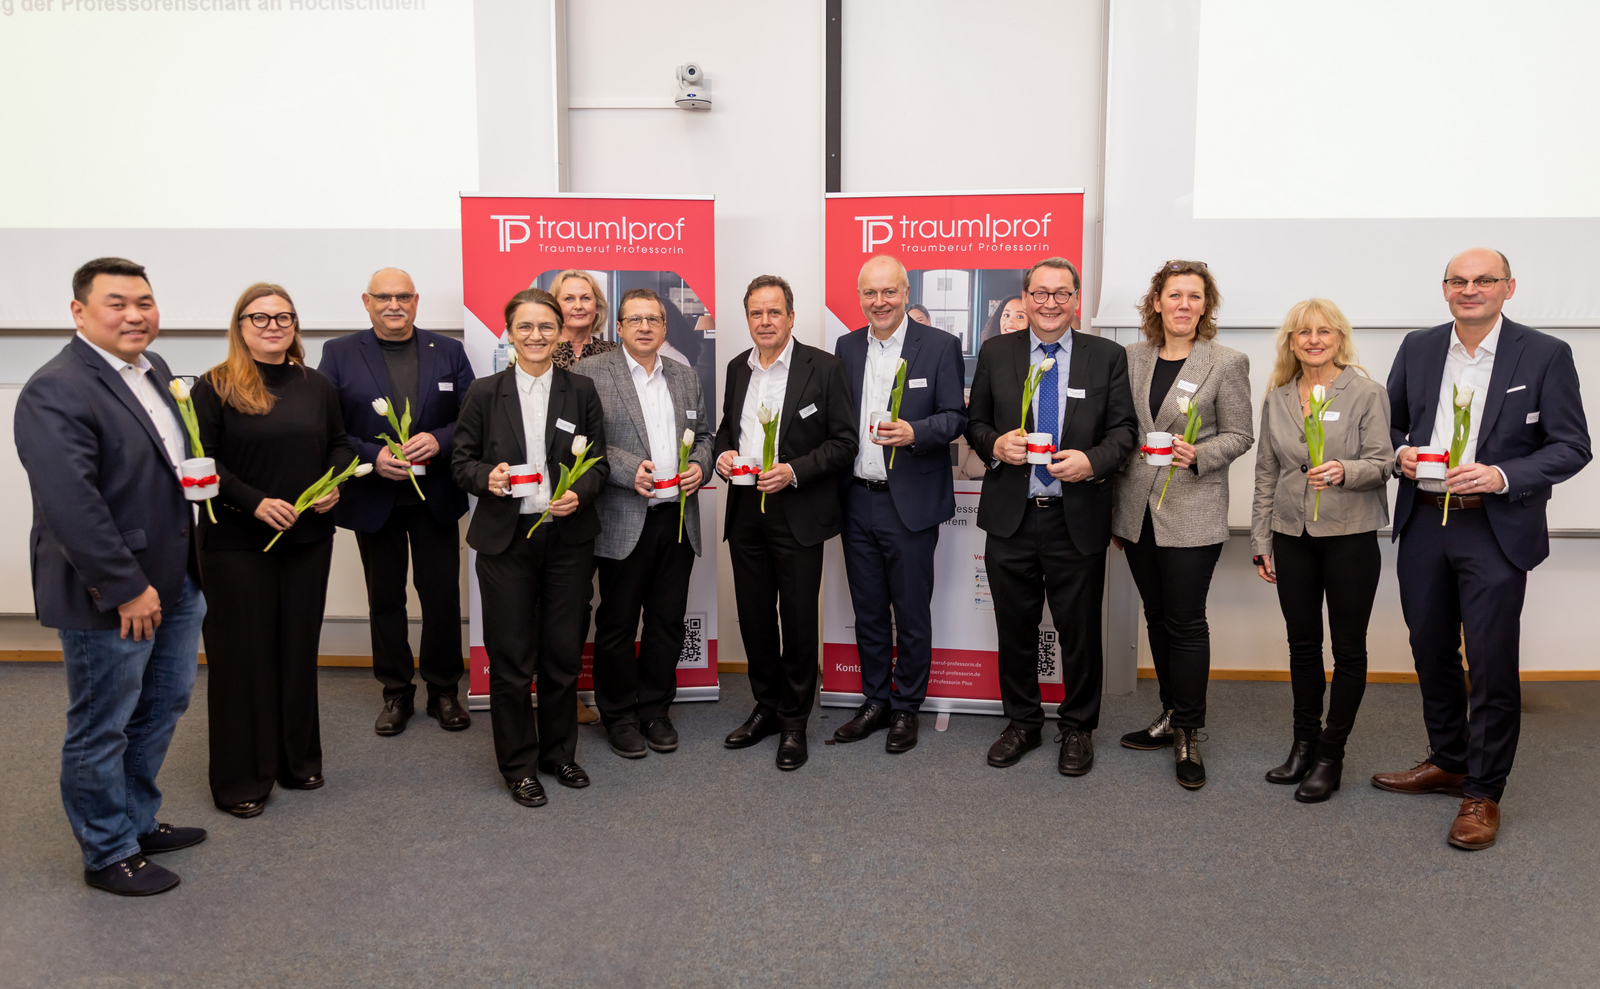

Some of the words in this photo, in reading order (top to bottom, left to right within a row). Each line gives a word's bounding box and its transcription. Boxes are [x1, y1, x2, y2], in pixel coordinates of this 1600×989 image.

[21, 0, 52, 11] der
[61, 0, 251, 11] Professorenschaft
[257, 0, 282, 11] an
[290, 0, 426, 11] Hochschulen
[539, 243, 610, 253] Traumberuf
[615, 244, 684, 254] Professorin
[901, 243, 973, 253] Traumberuf
[978, 242, 1050, 252] Professorin
[835, 663, 862, 673] Konta
